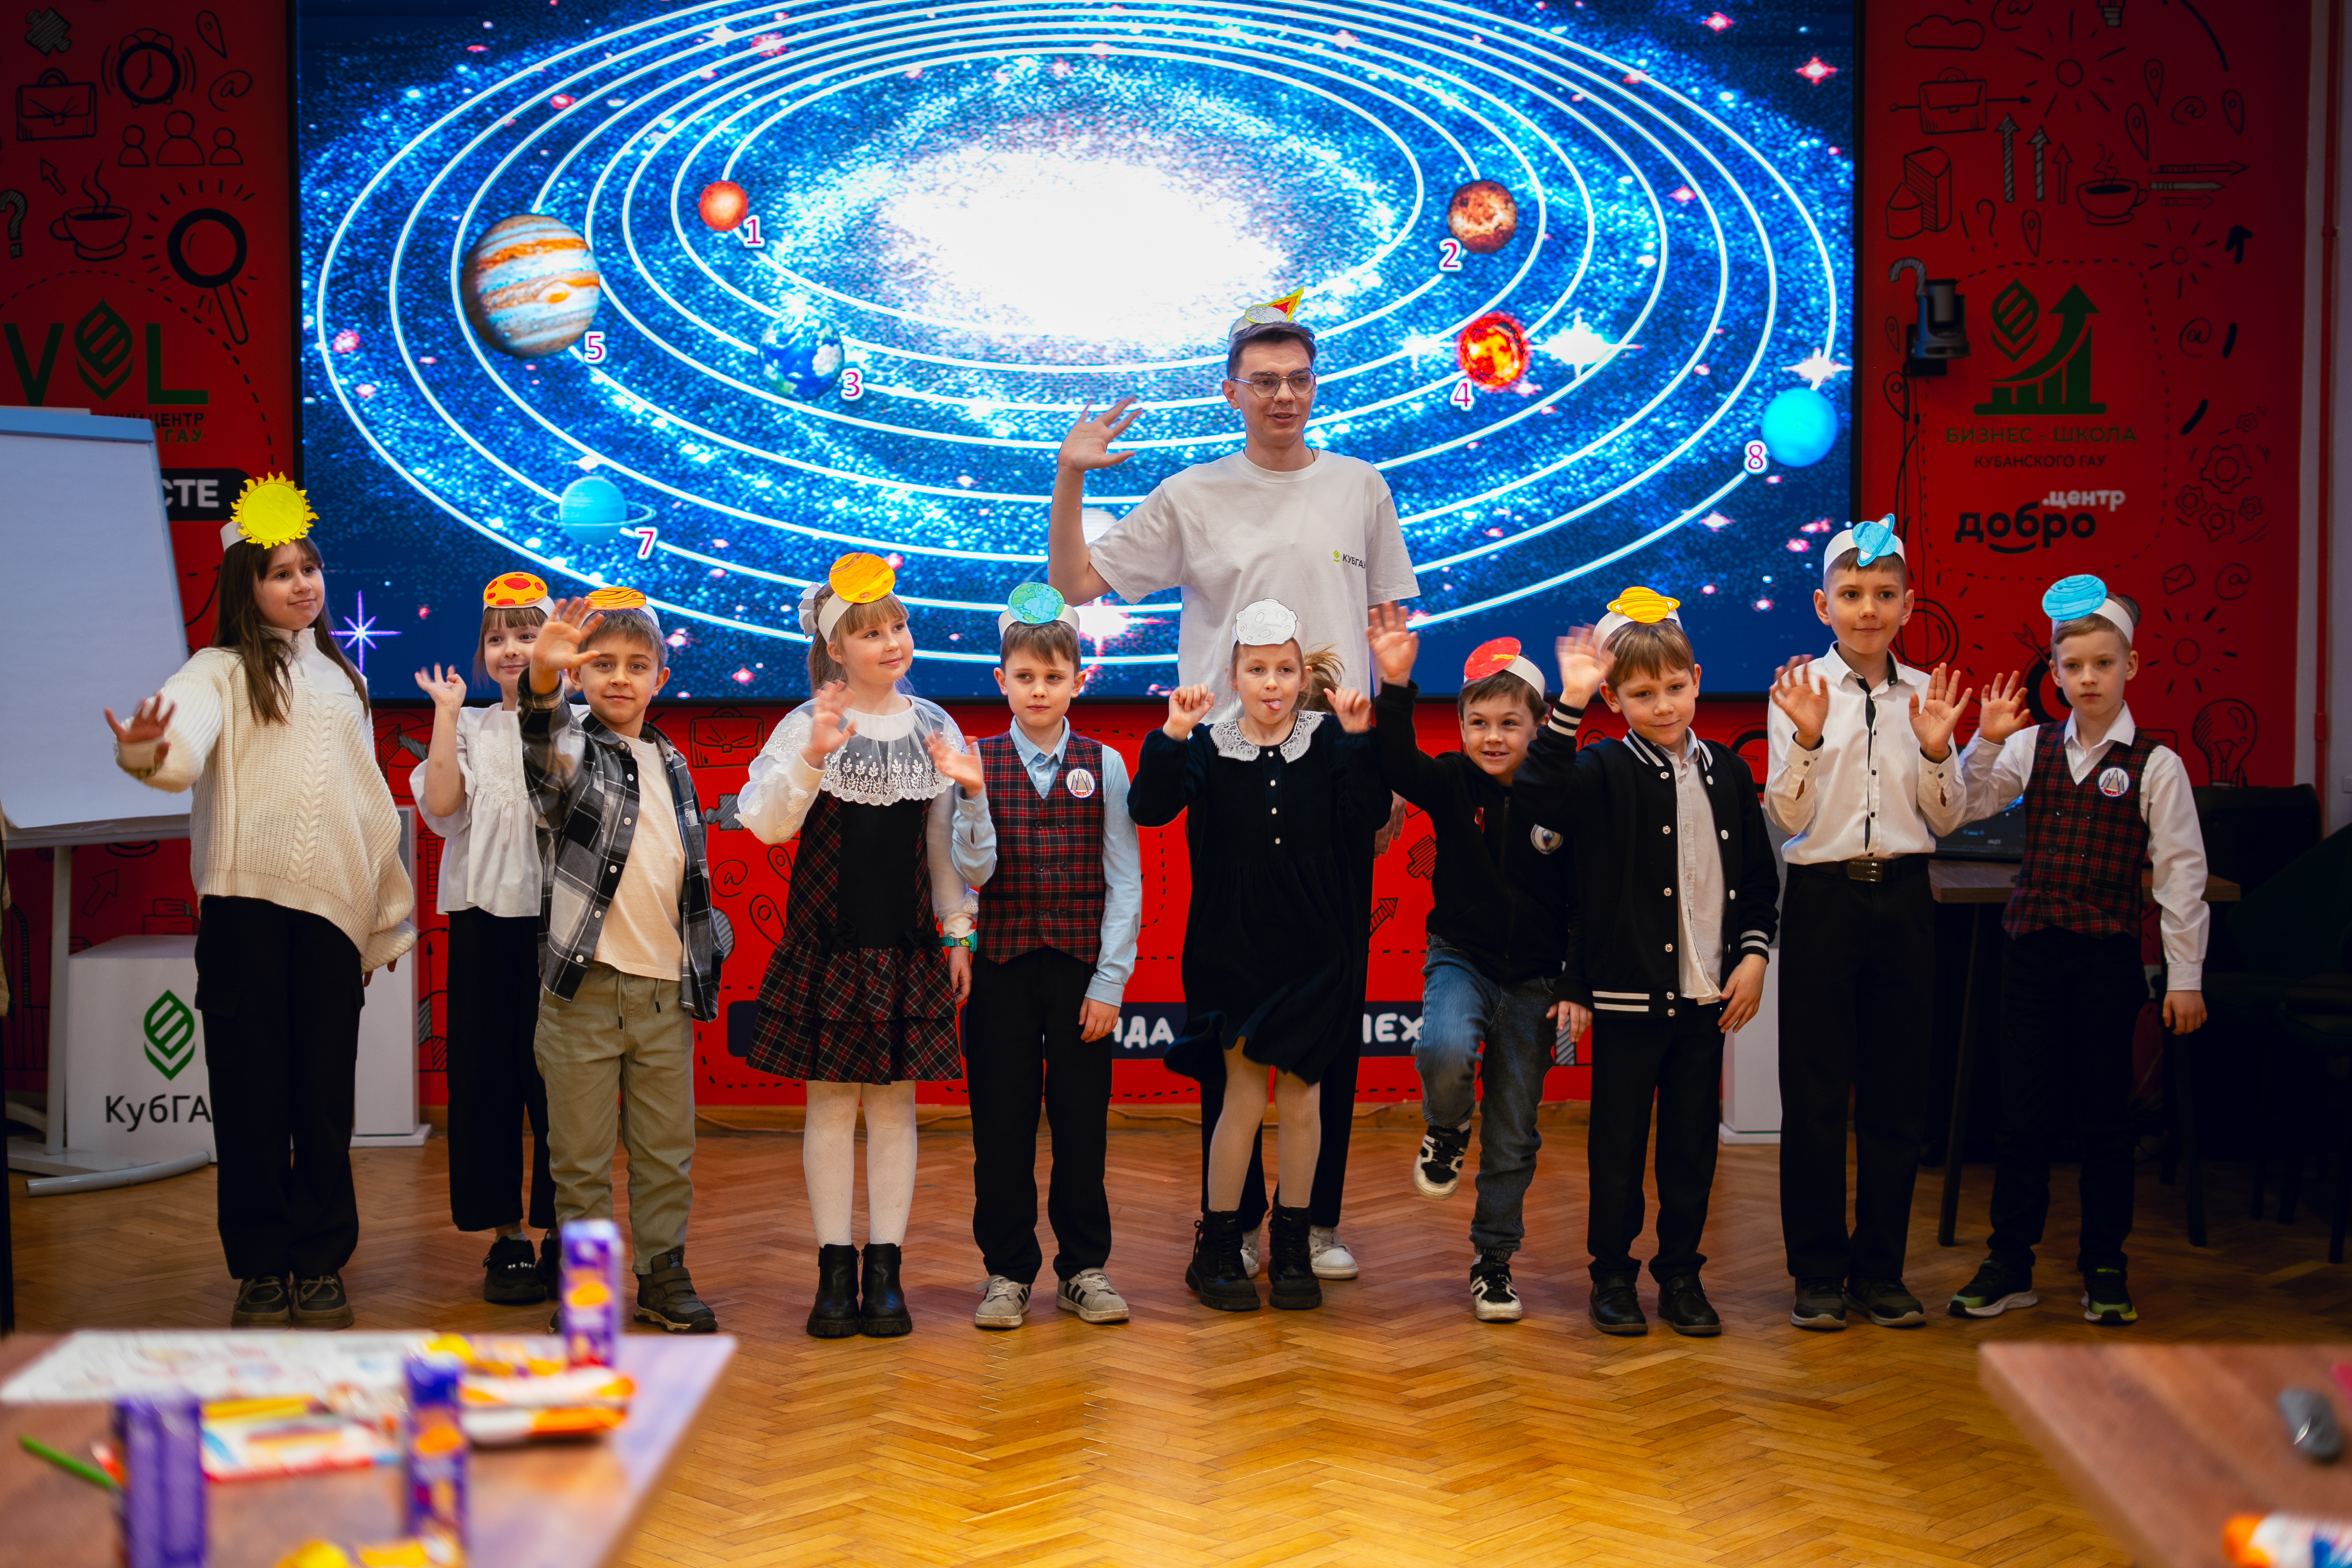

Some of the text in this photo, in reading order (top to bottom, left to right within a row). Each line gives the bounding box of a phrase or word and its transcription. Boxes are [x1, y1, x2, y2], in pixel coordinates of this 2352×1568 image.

[743, 214, 765, 248] 1
[1439, 238, 1462, 272] 2
[583, 331, 607, 364] 5
[840, 368, 865, 401] 3
[1450, 378, 1476, 411] 4
[164, 429, 203, 444] ГАУ
[1946, 427, 2033, 444] БИЗНЕС
[2053, 427, 2137, 444] ШКОЛА
[1744, 440, 1769, 475] 8
[1974, 455, 2106, 468] КУБАНСКОГО ГАУ
[1954, 501, 2097, 549] добро
[634, 526, 658, 560] 7
